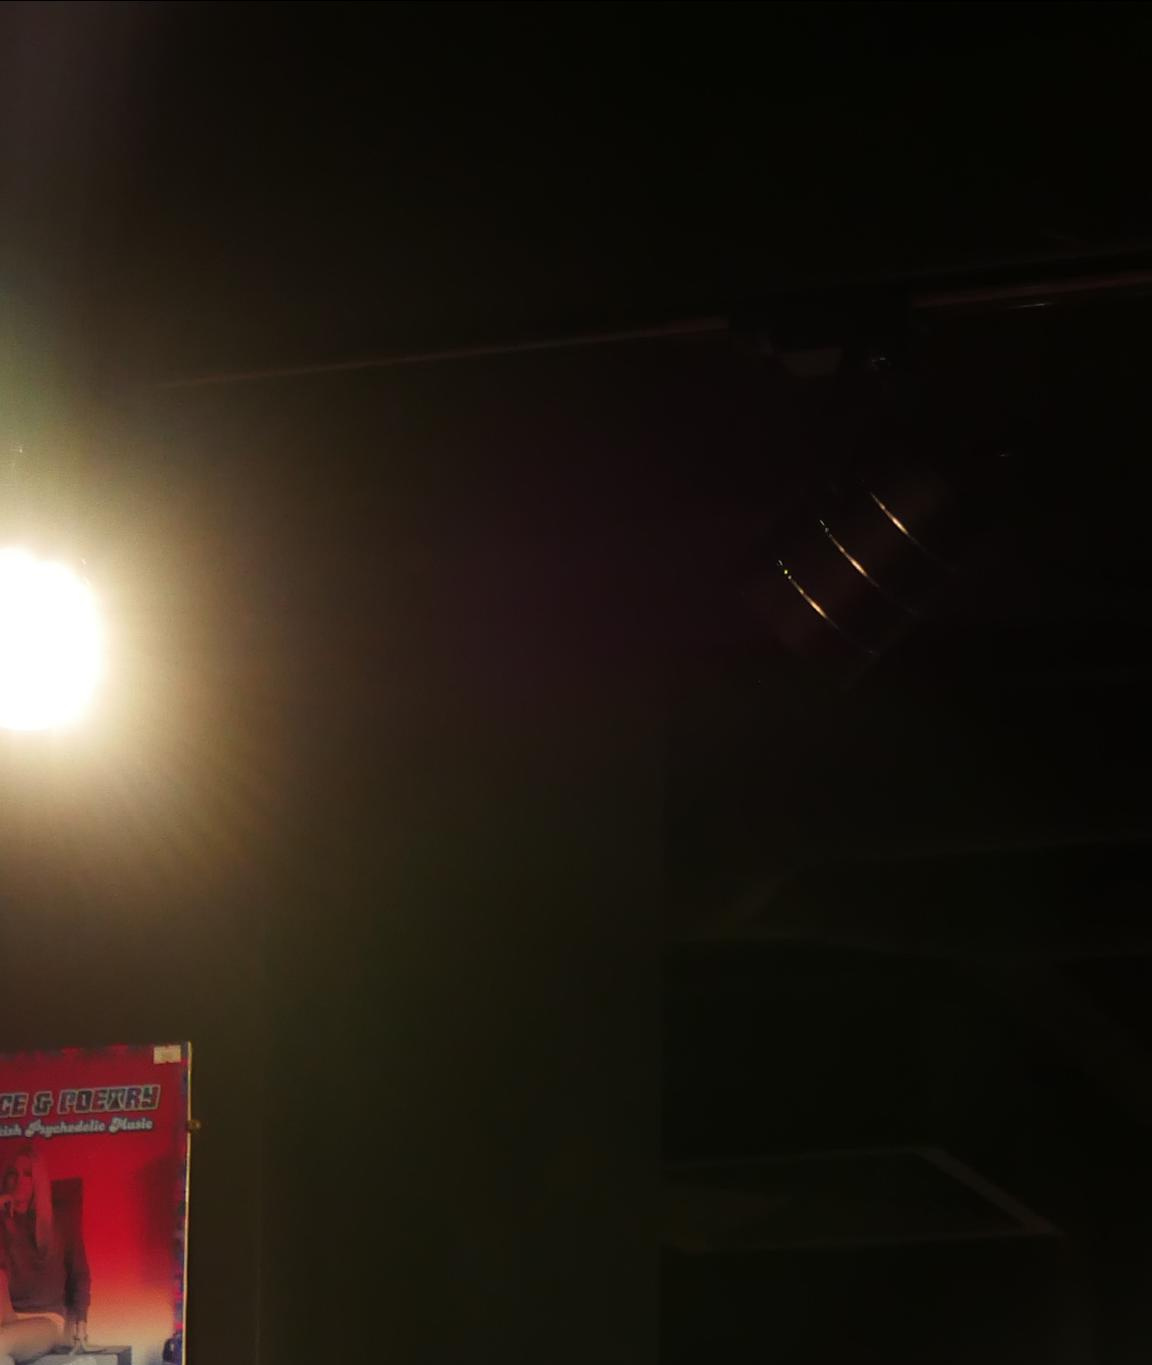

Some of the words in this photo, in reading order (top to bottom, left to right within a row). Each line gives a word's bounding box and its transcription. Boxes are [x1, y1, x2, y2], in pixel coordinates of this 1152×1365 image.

[57, 1084, 161, 1115] POETRY
[25, 1117, 106, 1138] Psychedelic
[109, 1116, 153, 1134] Music
